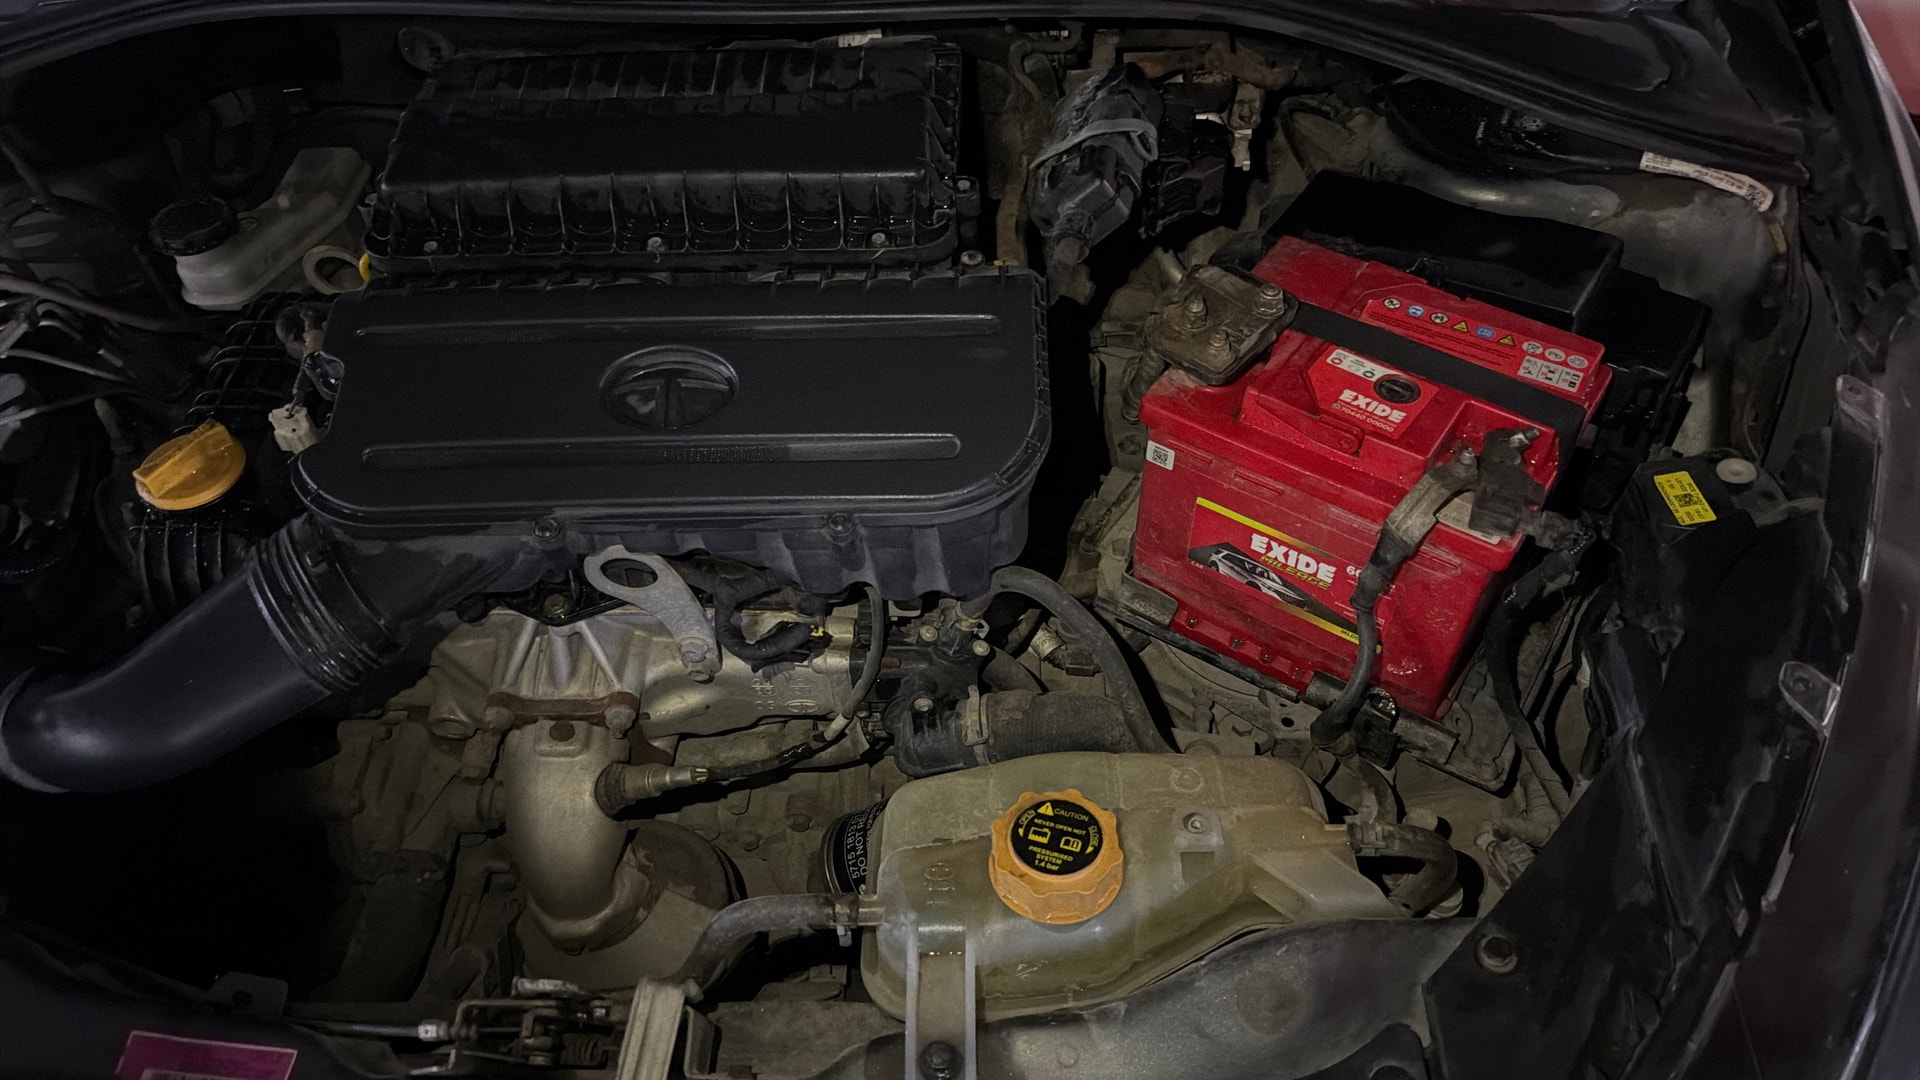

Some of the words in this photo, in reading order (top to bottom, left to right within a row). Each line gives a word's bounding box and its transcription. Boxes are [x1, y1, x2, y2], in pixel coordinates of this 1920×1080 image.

[1338, 388, 1407, 423] EXIDE
[1250, 532, 1337, 584] EXIDE
[1259, 554, 1332, 591] MILEAGE
[1018, 809, 1036, 825] OPEN
[1054, 807, 1089, 822] CAUTION
[846, 825, 857, 849] 1813
[1033, 818, 1055, 828] NEVER
[1054, 823, 1072, 833] OPEN
[1073, 827, 1087, 836] HOT
[1088, 825, 1099, 847] CLOSE
[855, 830, 865, 855] NOT
[1028, 845, 1074, 862] PRESSURISED
[1036, 854, 1063, 865] SYSTEM
[847, 851, 860, 879] 5715
[857, 857, 868, 876] DO
[1034, 860, 1046, 868] 1.4
[1046, 861, 1060, 871] bar
